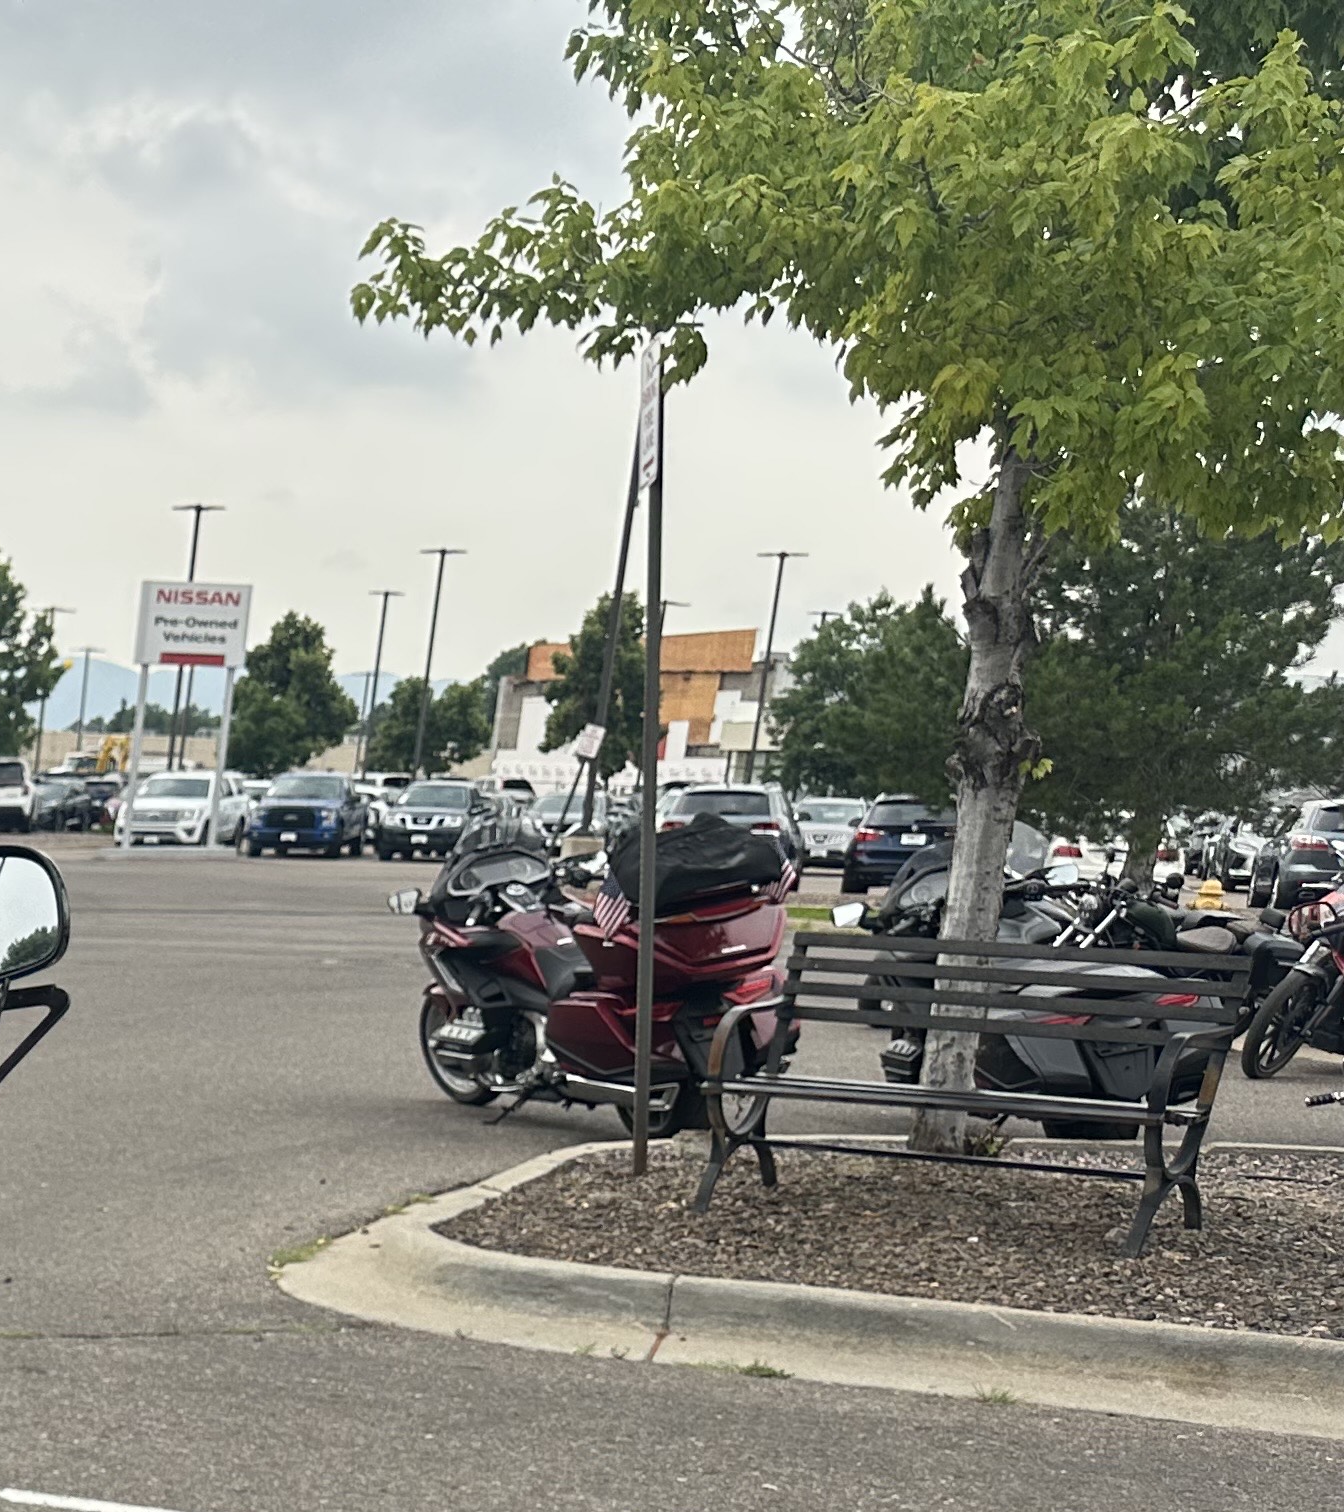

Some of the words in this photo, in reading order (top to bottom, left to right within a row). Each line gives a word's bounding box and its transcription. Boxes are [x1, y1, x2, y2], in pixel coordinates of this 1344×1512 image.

[156, 588, 241, 606] NISSAN
[154, 616, 239, 629] Pre-Owned
[162, 632, 226, 644] Vehicles
